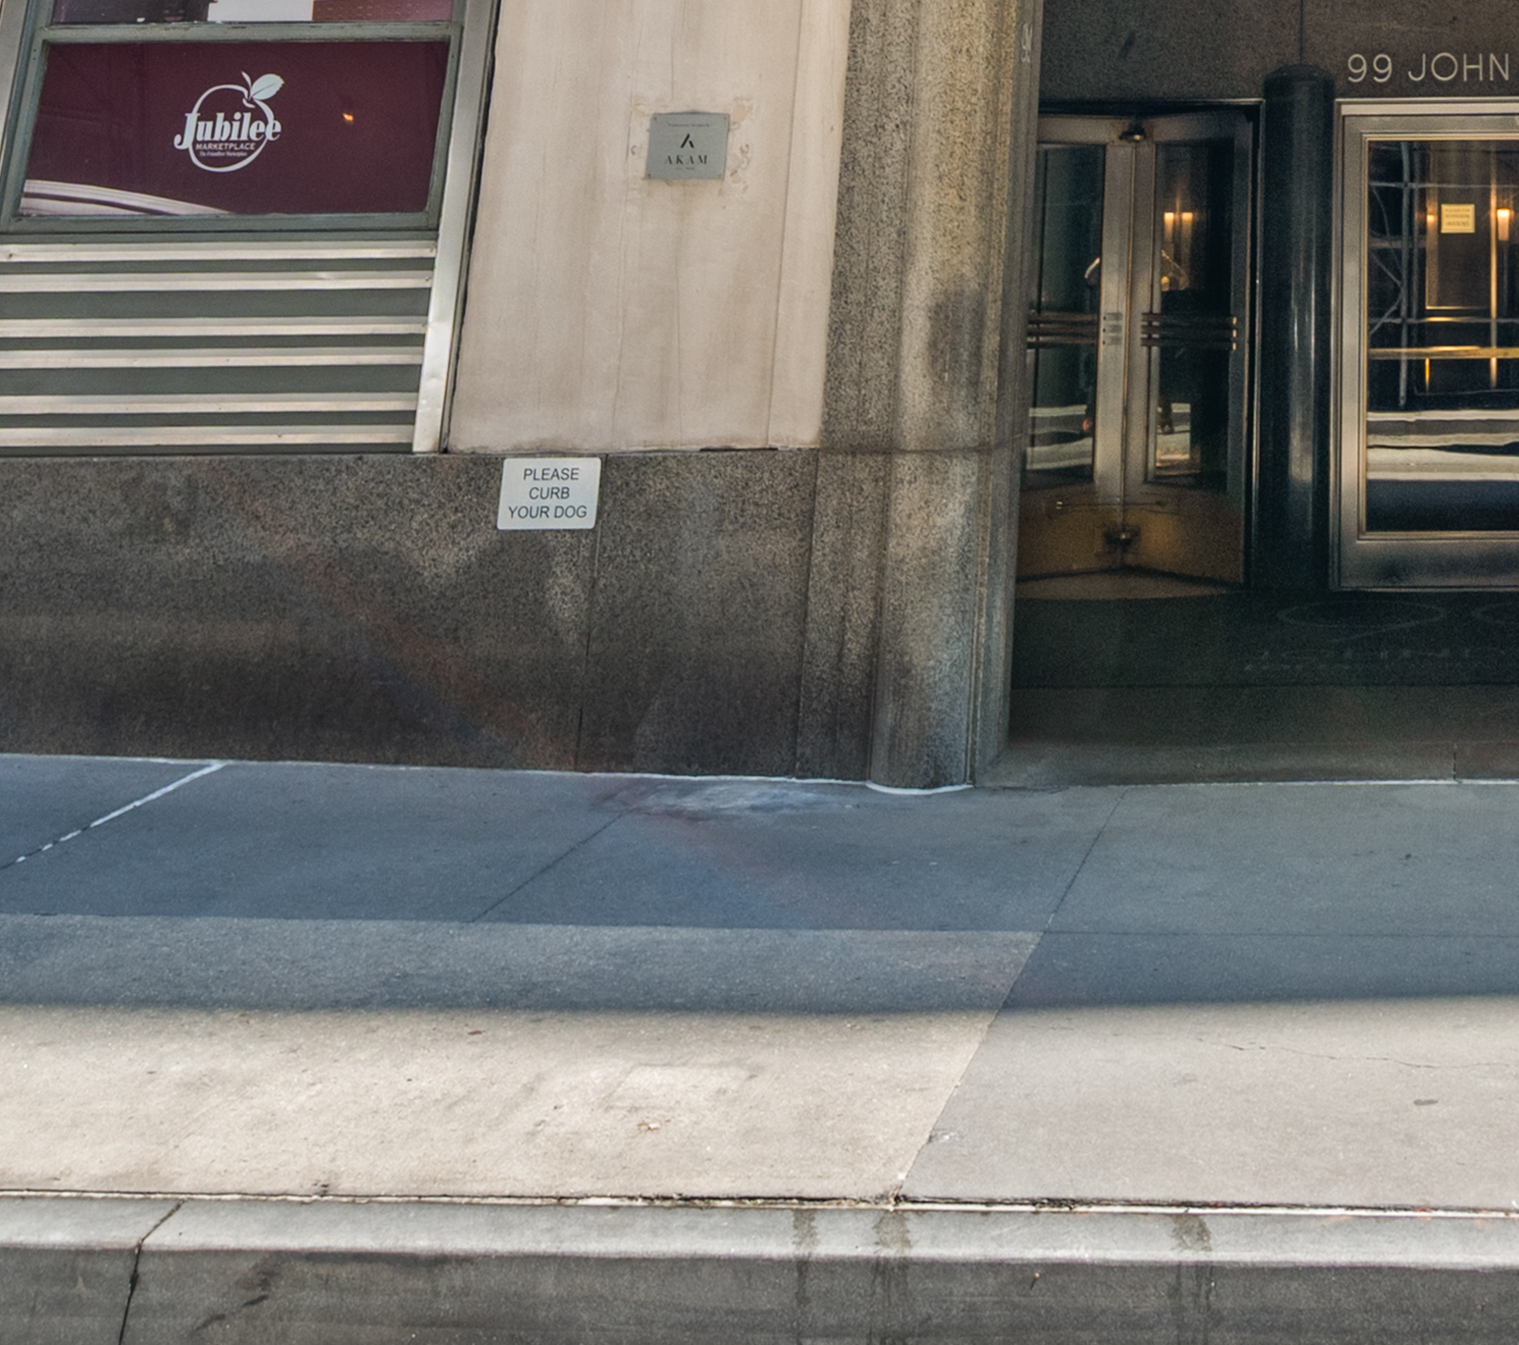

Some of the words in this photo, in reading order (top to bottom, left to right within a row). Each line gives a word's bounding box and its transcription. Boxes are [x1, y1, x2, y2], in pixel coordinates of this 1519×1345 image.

[1348, 54, 1392, 82] 99
[1408, 52, 1509, 81] JOHN
[174, 112, 281, 149] Jubilee
[523, 468, 580, 481] PLEASE
[529, 486, 570, 500] CURB
[508, 505, 550, 519] YOUR
[554, 505, 587, 519] DOG
